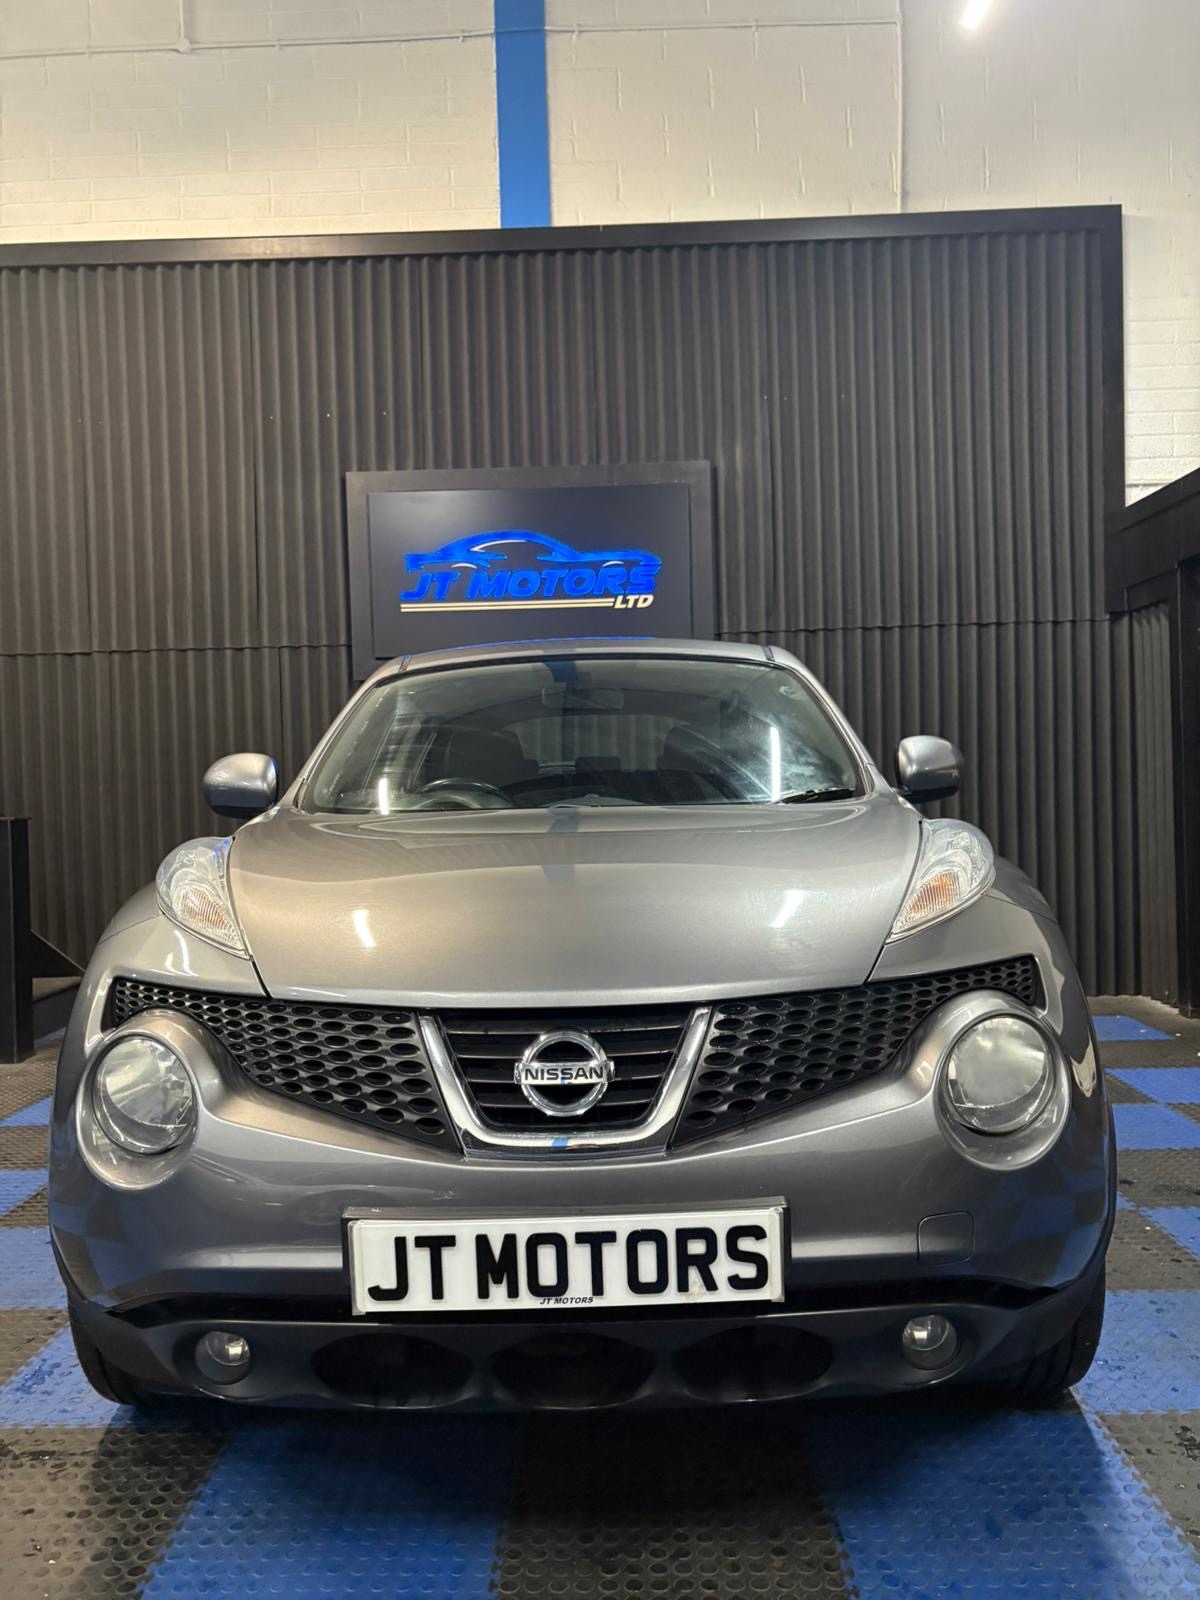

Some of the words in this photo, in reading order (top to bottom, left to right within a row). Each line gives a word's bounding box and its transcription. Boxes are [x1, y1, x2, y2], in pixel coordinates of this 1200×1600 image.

[400, 570, 461, 601] JT
[467, 567, 661, 598] MOTORS
[614, 594, 654, 609] LTD
[525, 1067, 603, 1080] NISSAN
[367, 1234, 456, 1302] JT
[475, 1224, 769, 1300] MOTORS
[554, 1296, 594, 1304] MOTORS
